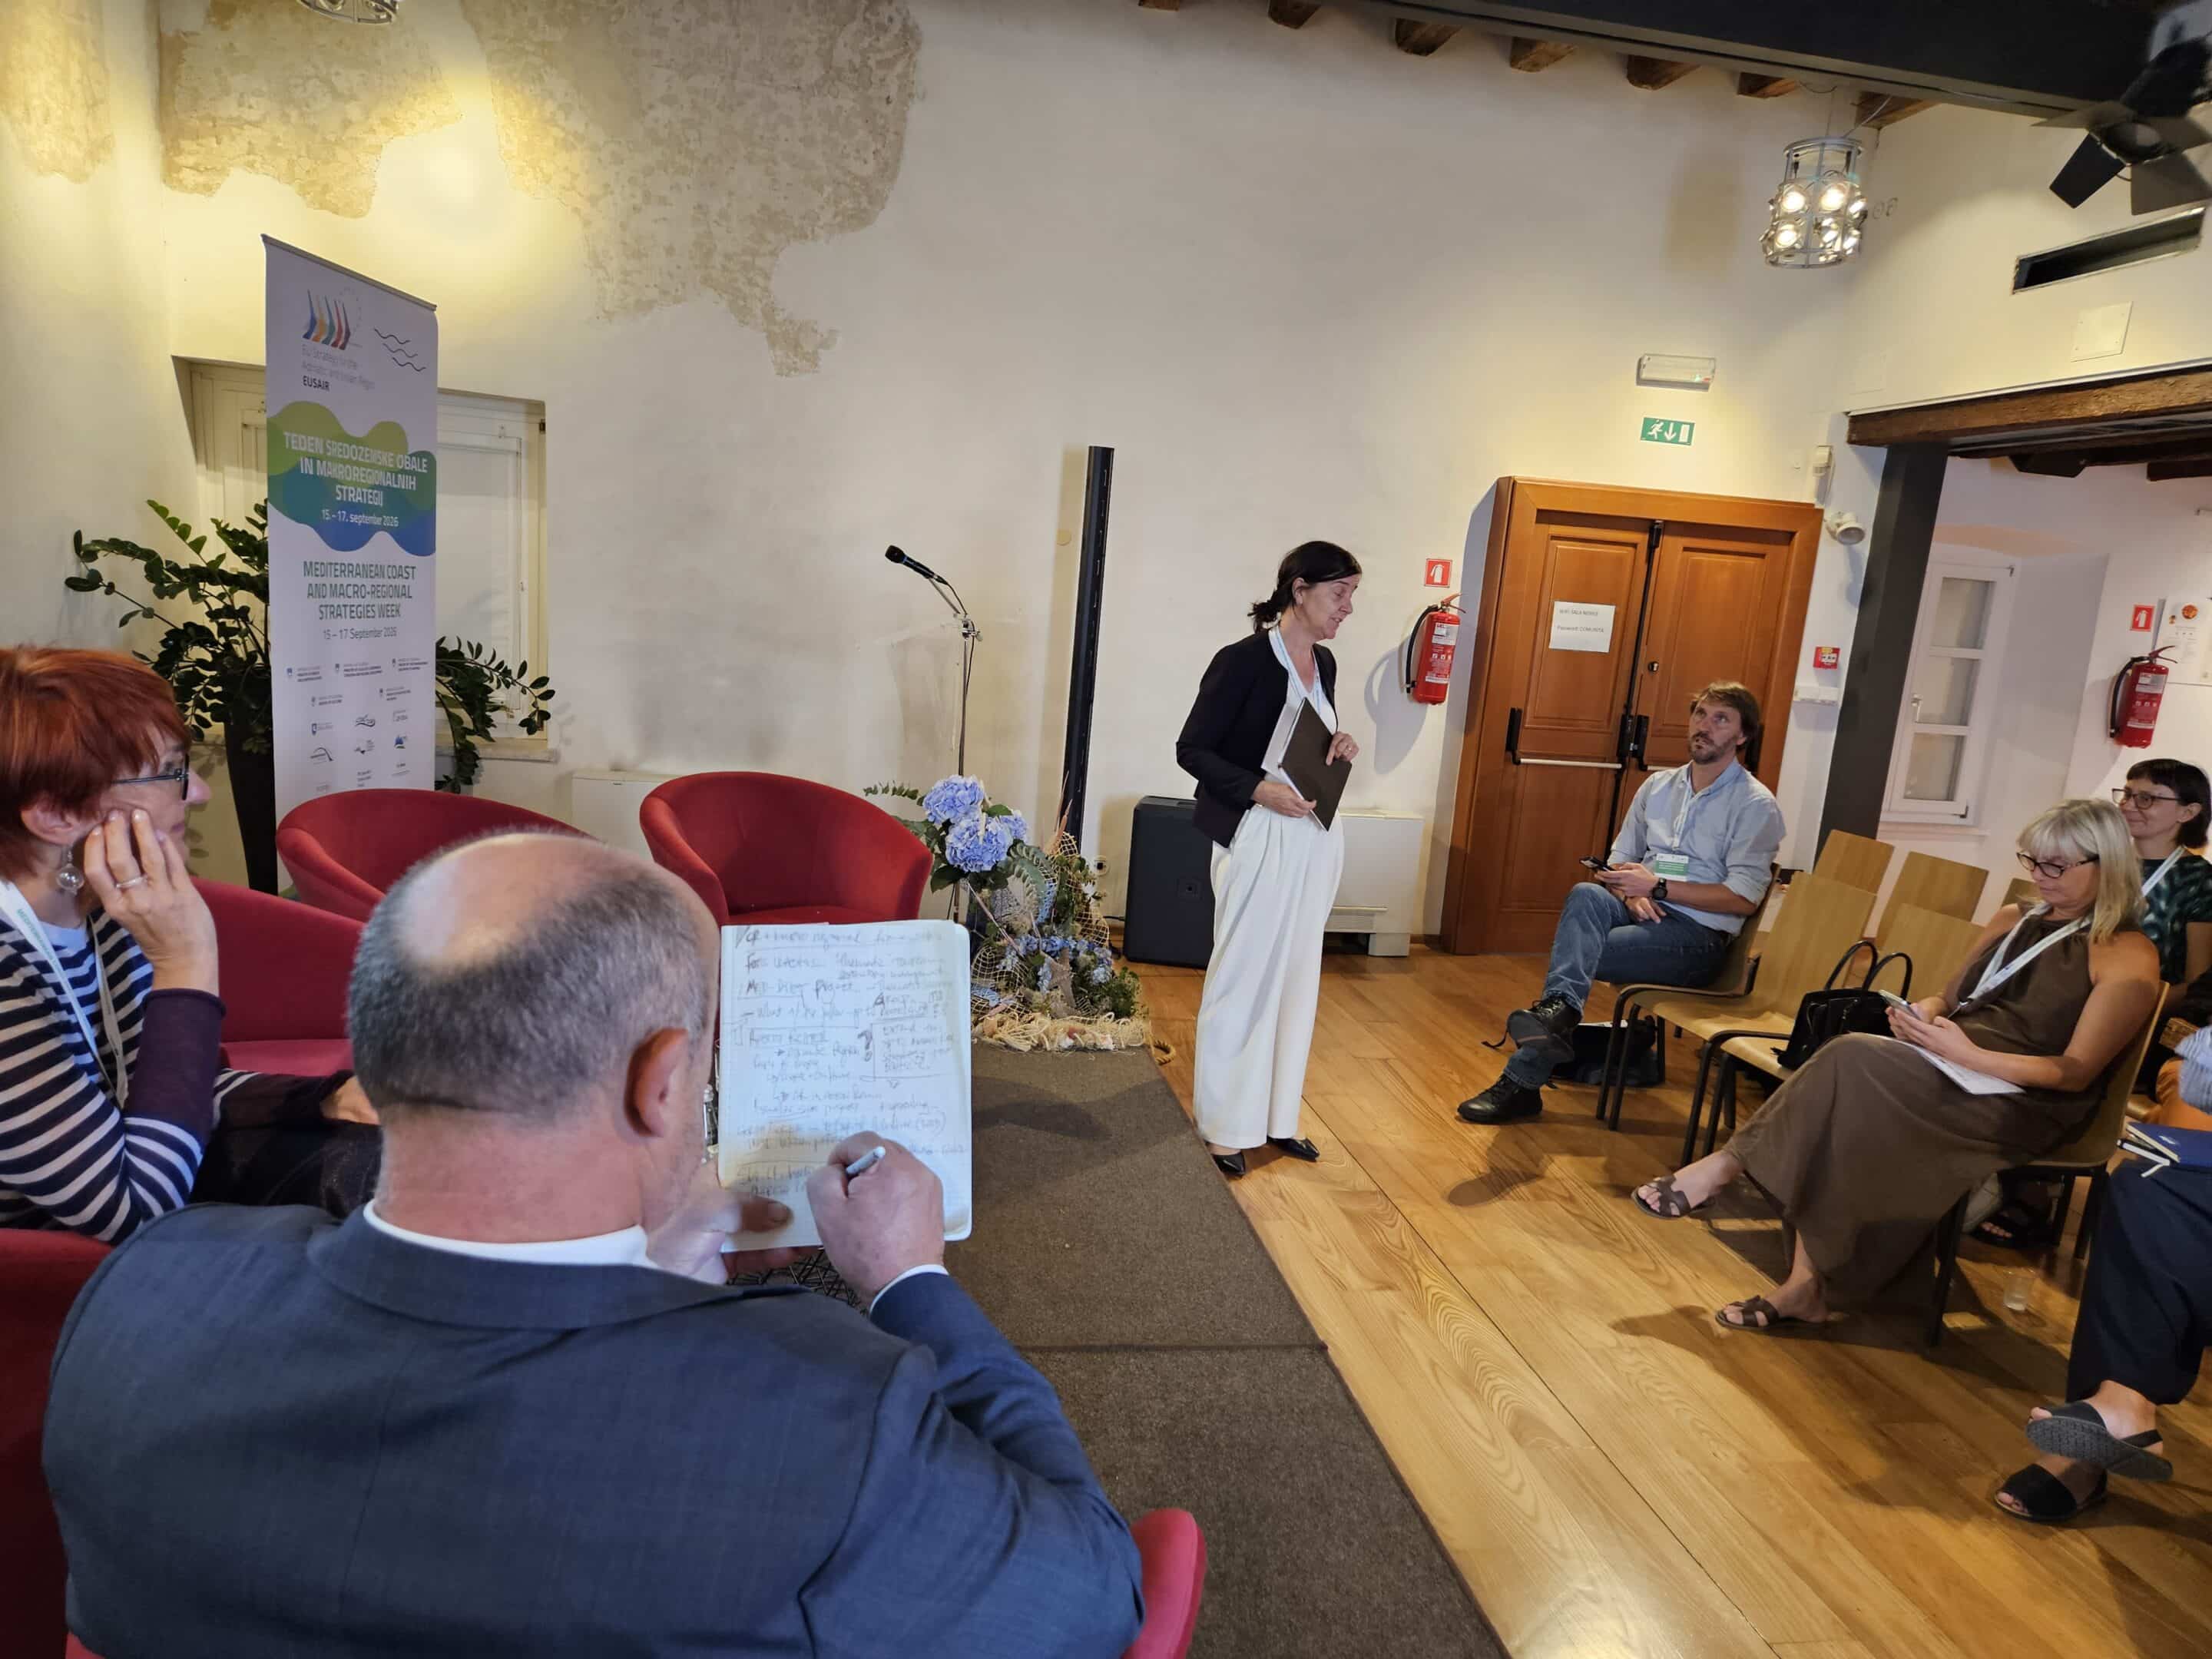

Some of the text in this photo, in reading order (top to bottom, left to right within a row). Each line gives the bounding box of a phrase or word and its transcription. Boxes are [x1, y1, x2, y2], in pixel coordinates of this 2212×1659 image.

[303, 375, 330, 391] EUSAIR
[283, 432, 323, 454] TEDEN
[396, 455, 428, 473] OBALE
[300, 457, 417, 490] IN MAKROREGIONALNIH
[349, 512, 382, 526] september
[303, 561, 416, 580] MEDITERRANEAN COAST
[307, 583, 412, 599] AND MACRO-REGIONAL
[319, 603, 401, 620] STRATEGIES WEEK
[339, 628, 349, 640] 17
[349, 627, 383, 641] September
